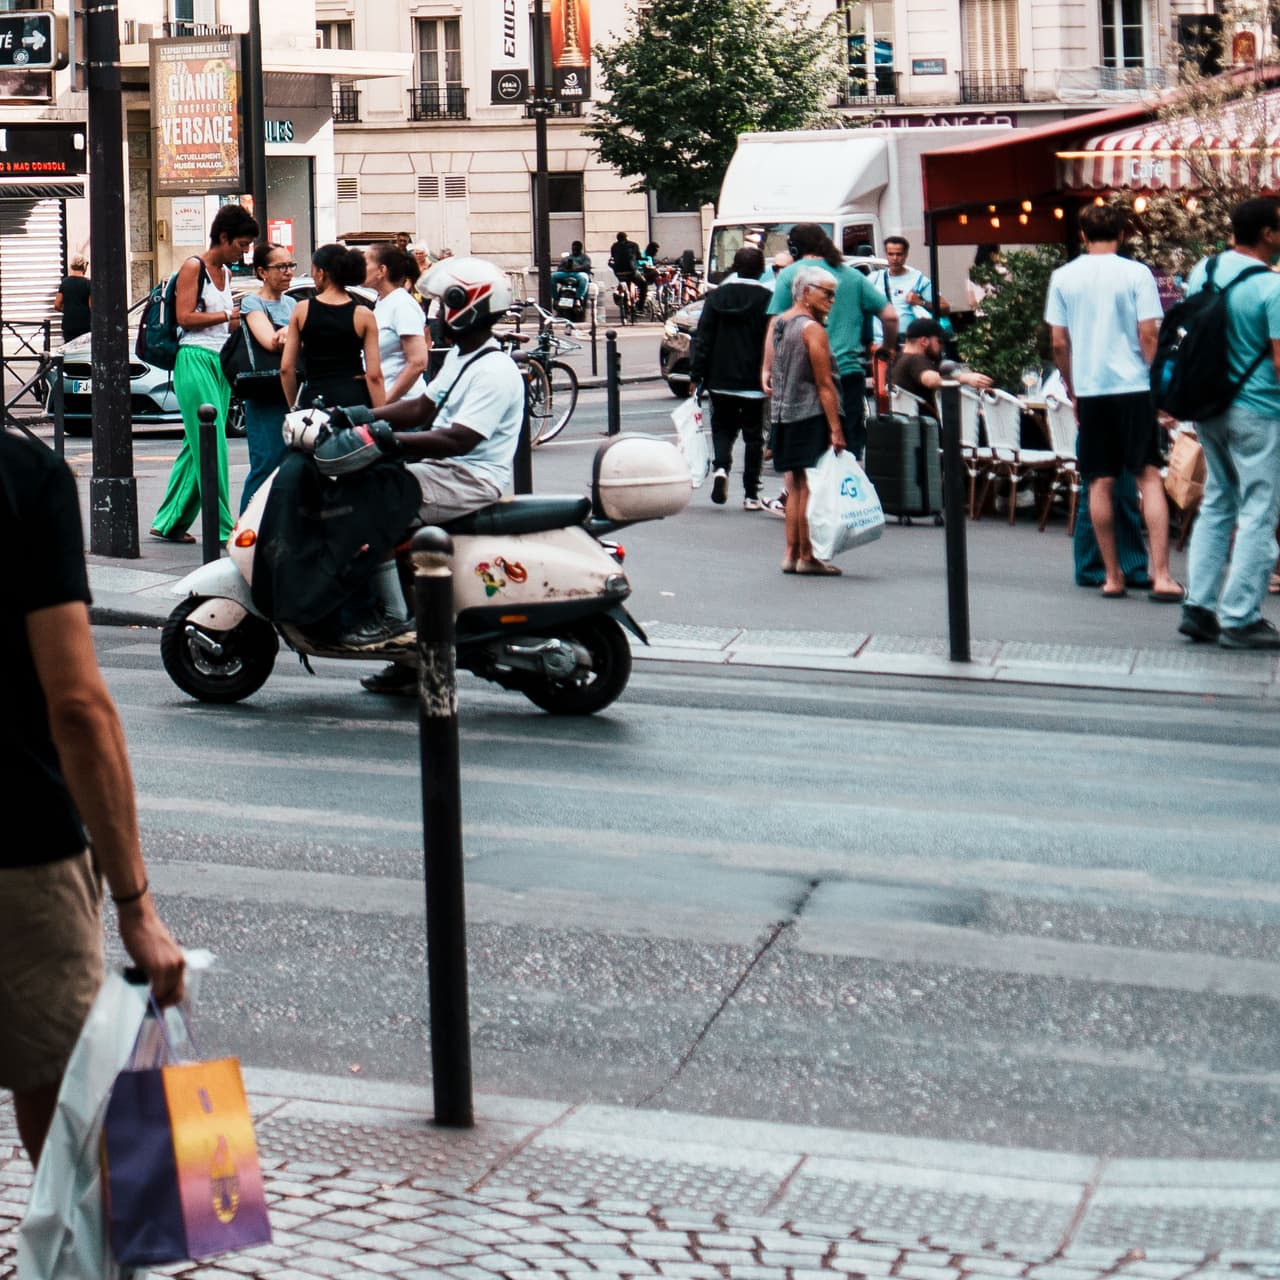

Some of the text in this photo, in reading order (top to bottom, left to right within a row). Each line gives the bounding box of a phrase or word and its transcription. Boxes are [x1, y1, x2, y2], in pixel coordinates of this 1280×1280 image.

[168, 72, 225, 101] GIANNI
[161, 116, 233, 145] VERSACE
[175, 153, 222, 161] ACTUELLEMENT
[13, 162, 30, 171] MAC
[31, 161, 66, 171] CONSOLE
[77, 382, 89, 392] FJ
